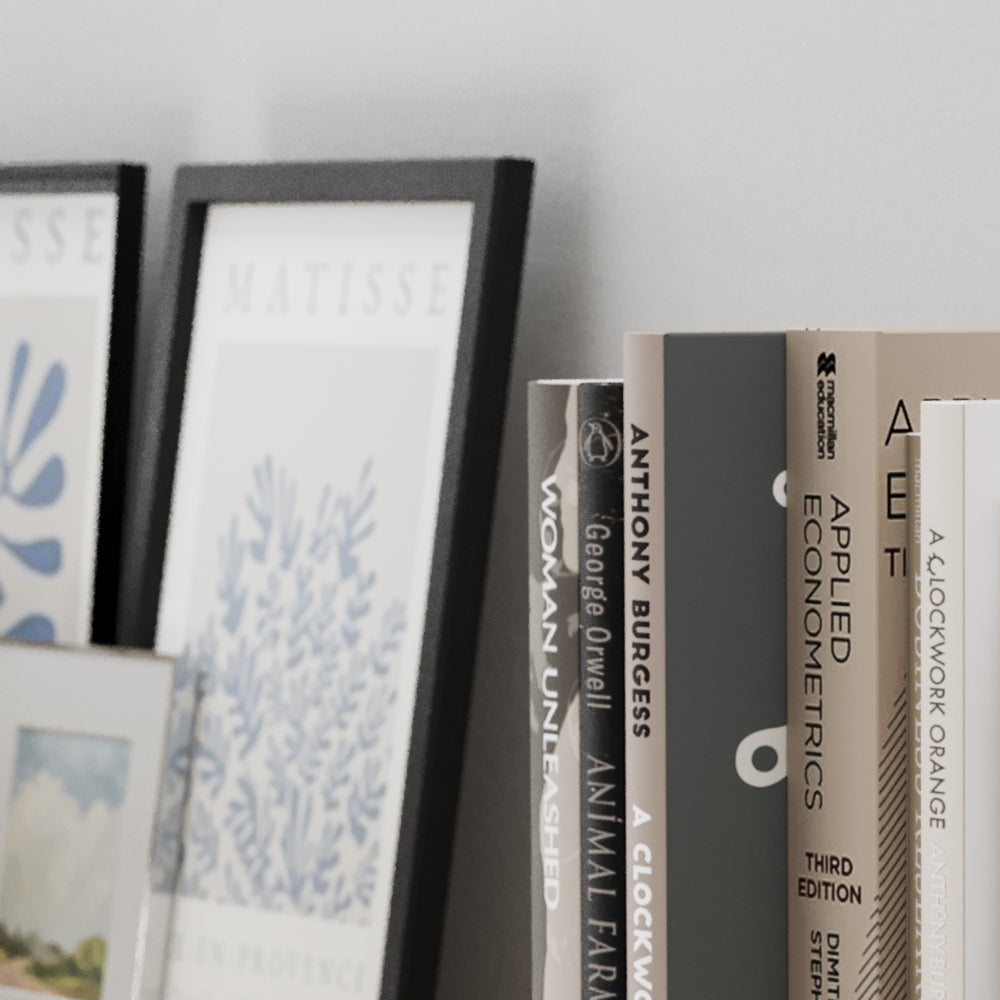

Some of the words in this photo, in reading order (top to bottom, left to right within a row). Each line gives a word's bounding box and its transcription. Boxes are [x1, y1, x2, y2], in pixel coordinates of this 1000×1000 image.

[222, 259, 452, 319] MATISSE
[816, 379, 827, 461] education
[827, 379, 838, 461] macmillan
[630, 423, 650, 585] ANTHONY
[929, 528, 945, 545] A
[541, 474, 559, 653] WOMAN
[581, 522, 612, 617] George
[830, 494, 851, 665] APPLIED
[586, 626, 613, 709] Orwell
[632, 600, 651, 739] BURGESS
[803, 494, 823, 811] ECONOMETRICS
[926, 552, 946, 716] CLOCKWORK
[542, 667, 560, 912] UNLEASHED
[587, 753, 624, 902] ANIMAL
[632, 803, 652, 829] A
[929, 724, 947, 829] ORANGE
[797, 877, 862, 905] EDITION
[804, 852, 854, 877] THIRD
[929, 842, 948, 956] ANTHONY
